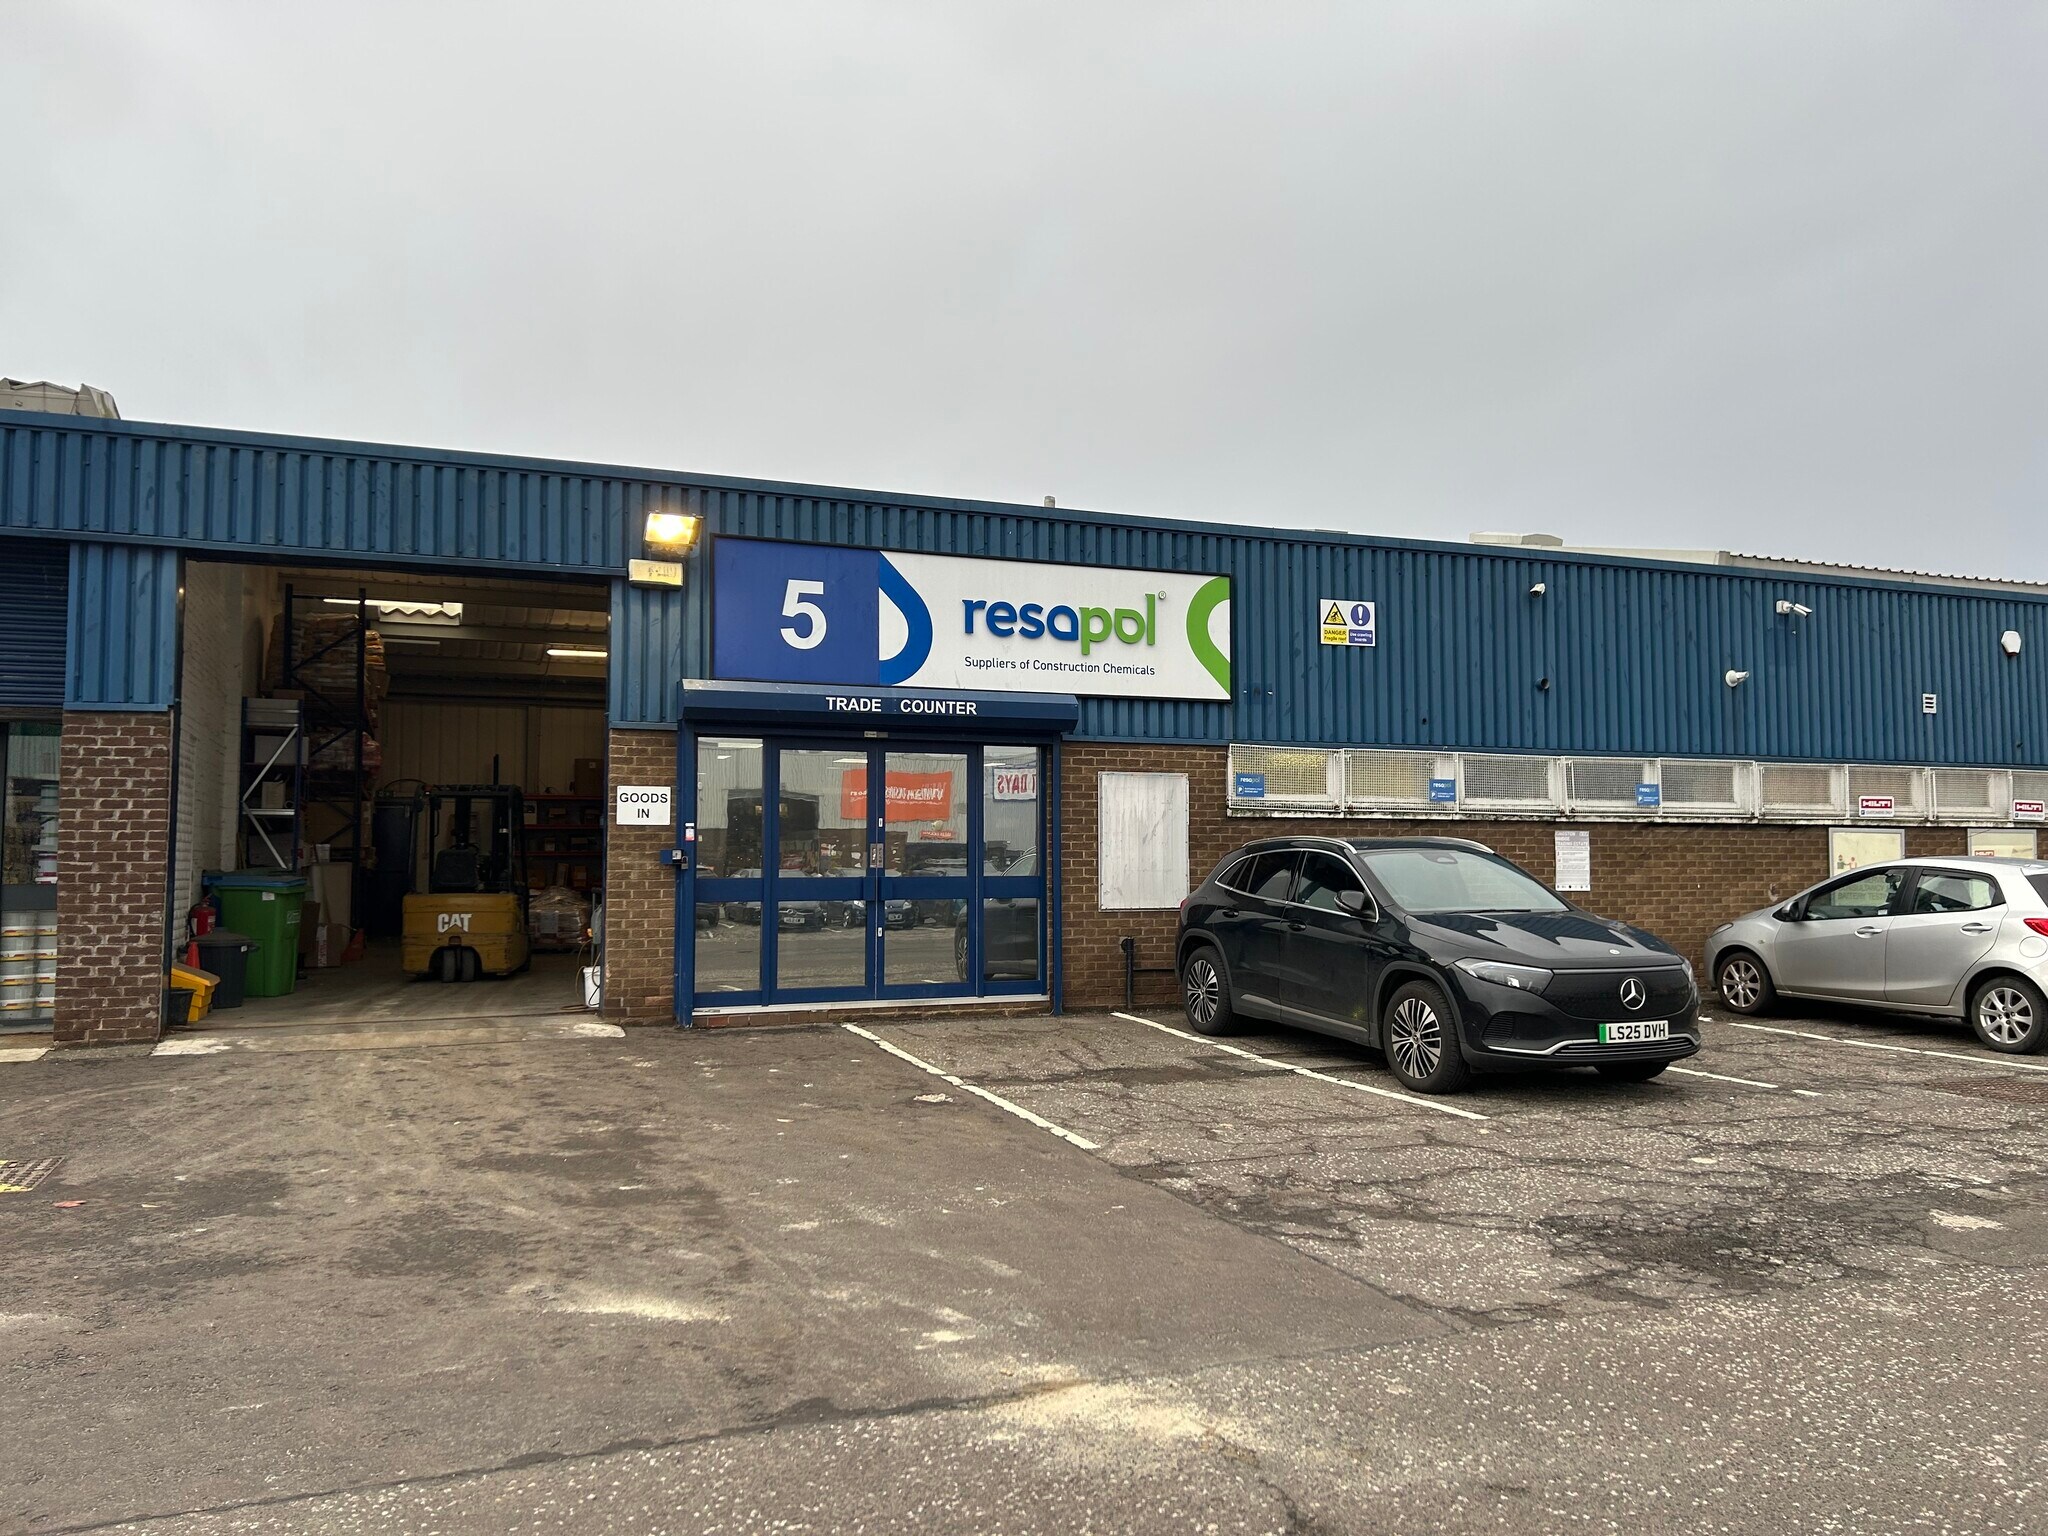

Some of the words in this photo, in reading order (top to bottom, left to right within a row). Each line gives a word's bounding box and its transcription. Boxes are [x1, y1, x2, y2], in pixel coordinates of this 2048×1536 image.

[780, 579, 827, 650] 5
[964, 656, 1017, 670] Suppliers
[1019, 659, 1030, 670] of
[1033, 660, 1100, 673] Construction
[1103, 664, 1156, 676] Chemicals
[826, 697, 882, 712] TRADE
[900, 699, 978, 715] COUNTER
[619, 792, 668, 804] GOODS
[637, 808, 650, 819] IN
[2016, 803, 2042, 811] HILTI
[437, 913, 473, 933] CAT
[1608, 1025, 1641, 1040] LS25
[1644, 1023, 1666, 1039] DVH
